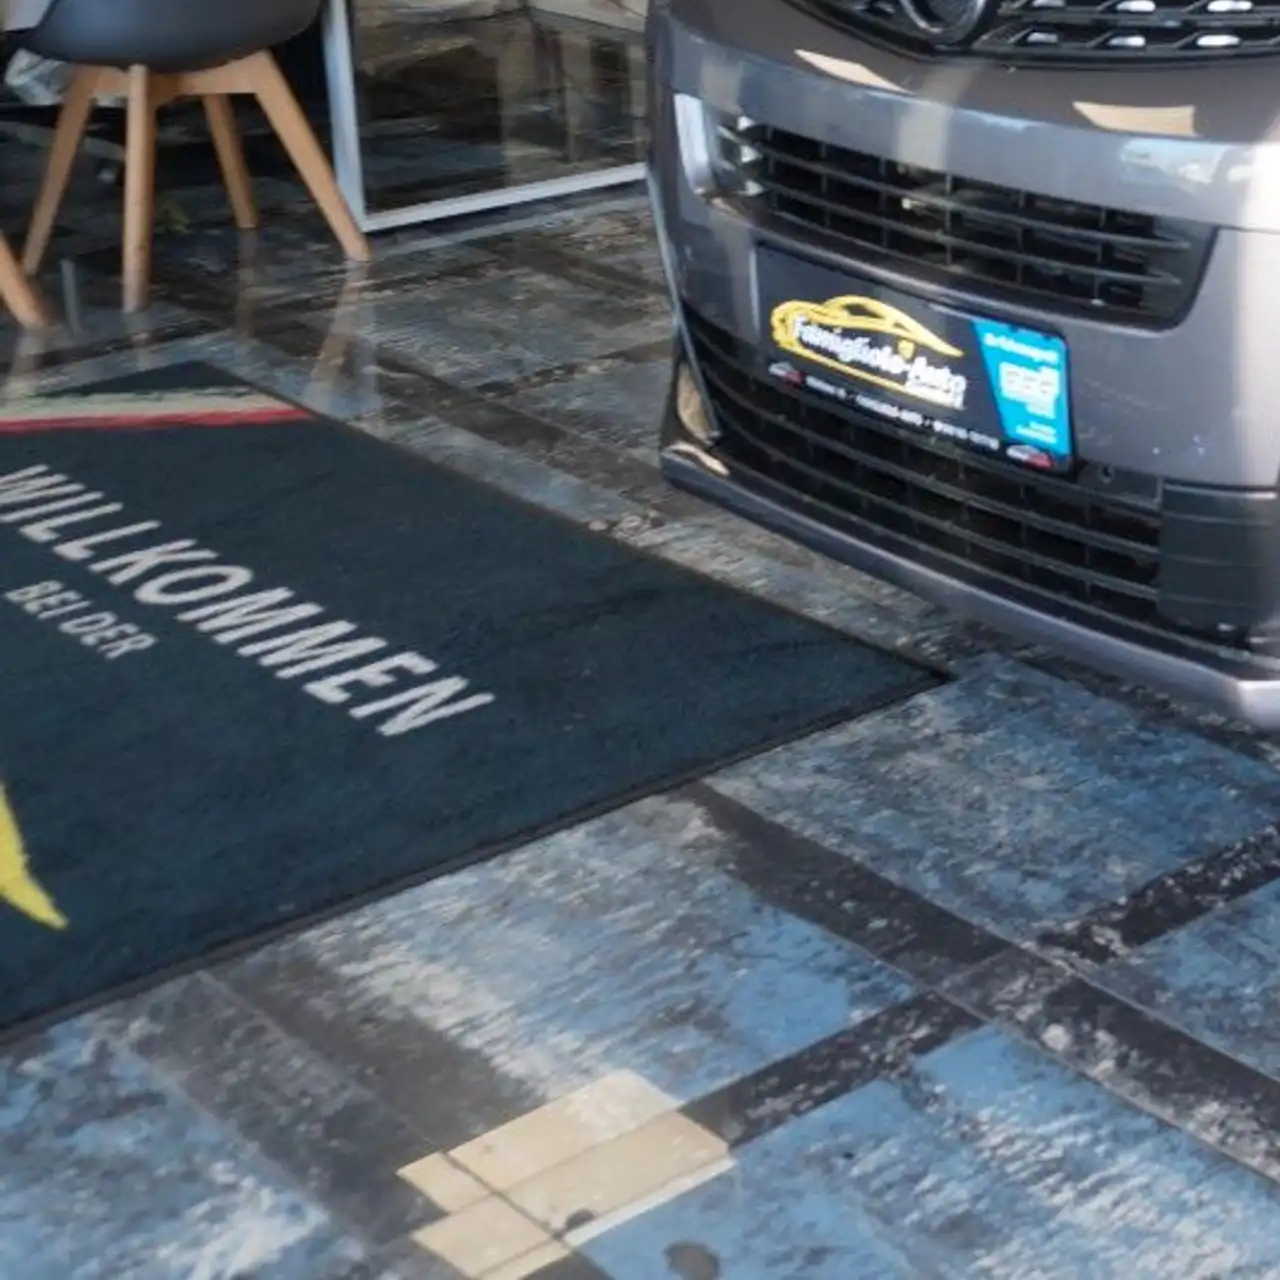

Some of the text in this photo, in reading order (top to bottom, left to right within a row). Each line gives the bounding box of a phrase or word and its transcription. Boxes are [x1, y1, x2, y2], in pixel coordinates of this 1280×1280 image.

[0, 464, 495, 736] WILLKOMMEN
[5, 580, 158, 659] BEI DER
